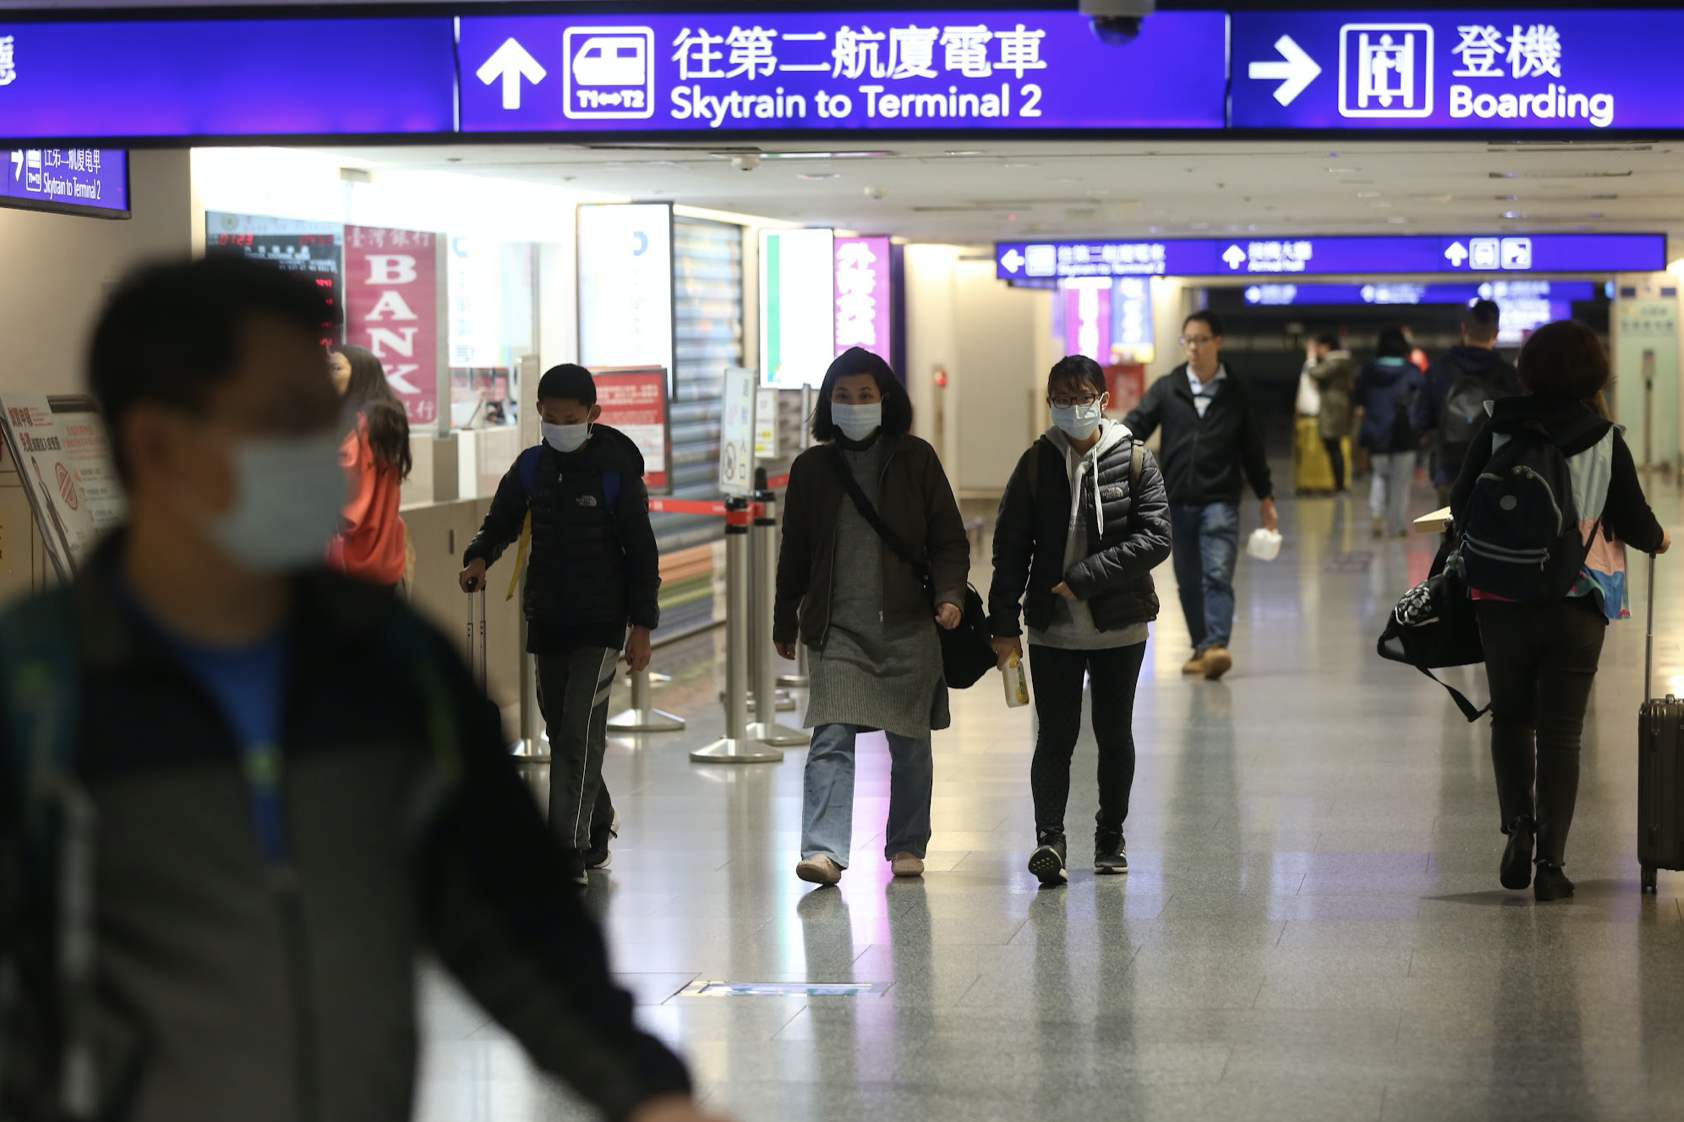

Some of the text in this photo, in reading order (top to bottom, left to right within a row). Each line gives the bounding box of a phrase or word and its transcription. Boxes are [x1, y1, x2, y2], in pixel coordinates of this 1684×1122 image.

[672, 24, 1047, 80] 往第二航廈電車
[1452, 24, 1562, 79] 登機
[670, 84, 1042, 127] Skytrain to Terminal 2
[1449, 83, 1613, 127] Boarding
[43, 172, 66, 200] Skytrain
[73, 176, 97, 200] Terminal
[364, 254, 422, 395] BANK
